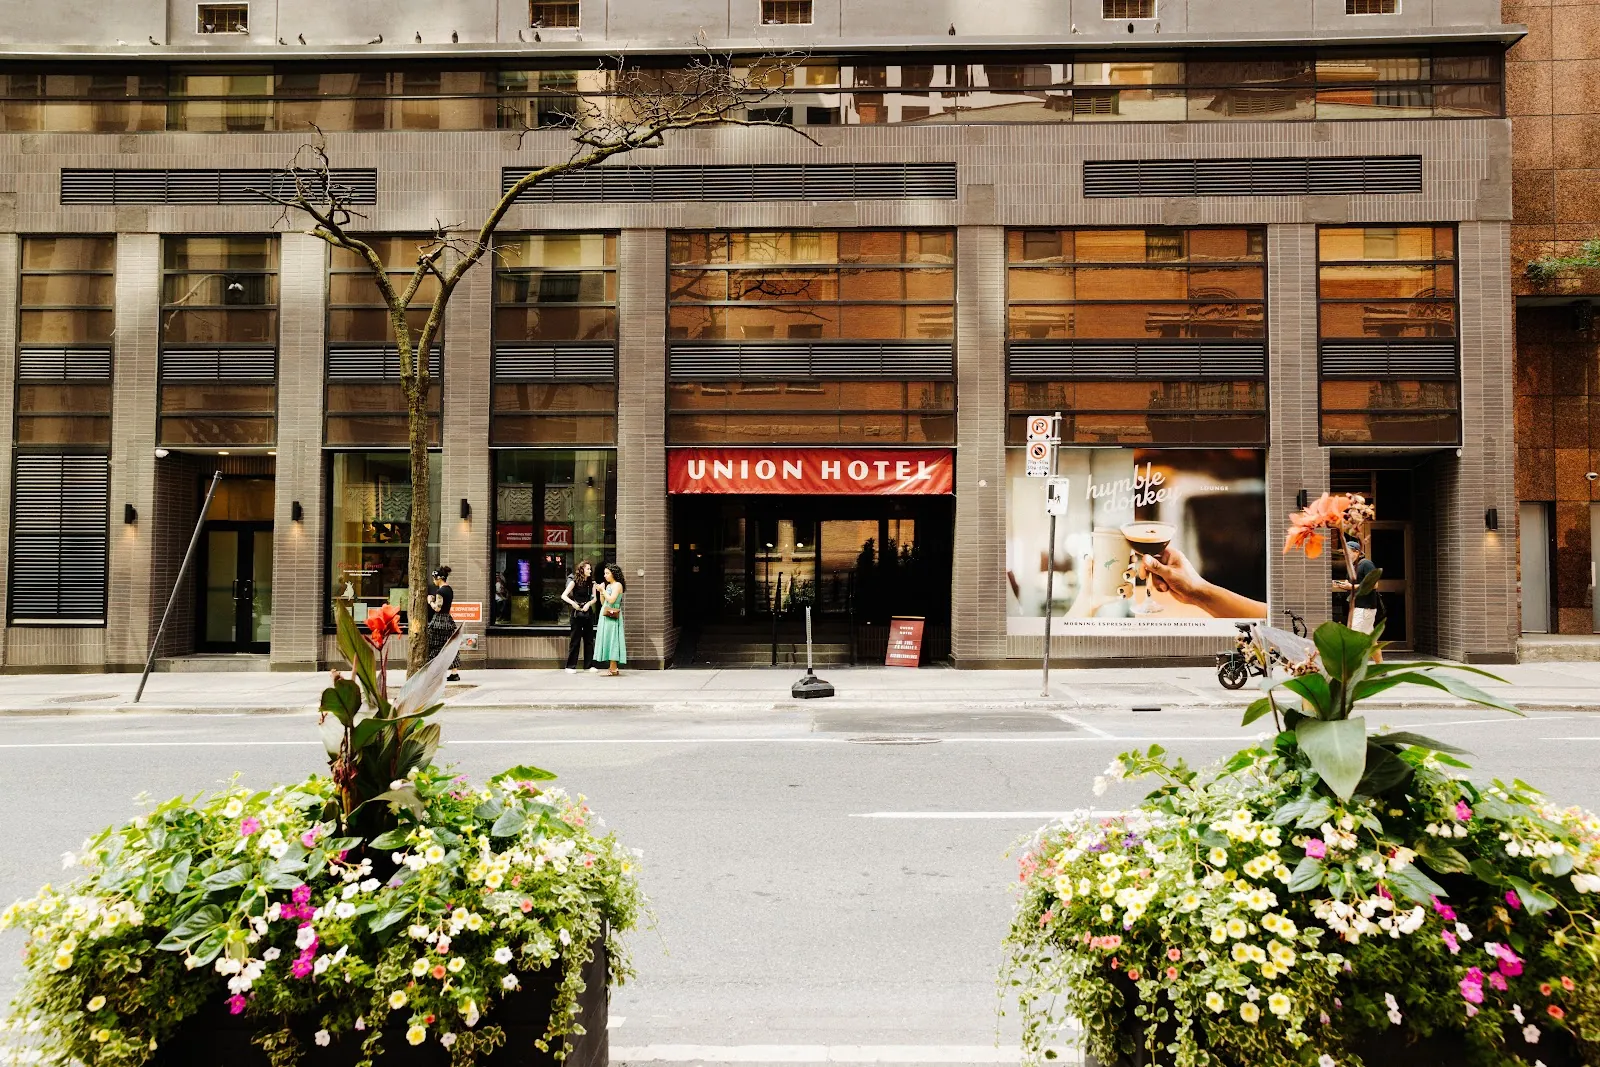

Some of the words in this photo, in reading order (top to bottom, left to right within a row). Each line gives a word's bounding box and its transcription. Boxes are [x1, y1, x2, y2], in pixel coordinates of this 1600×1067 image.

[687, 459, 803, 480] UNION
[821, 460, 932, 480] HOTEL
[1086, 462, 1166, 500] humble
[1103, 485, 1182, 514] donkey
